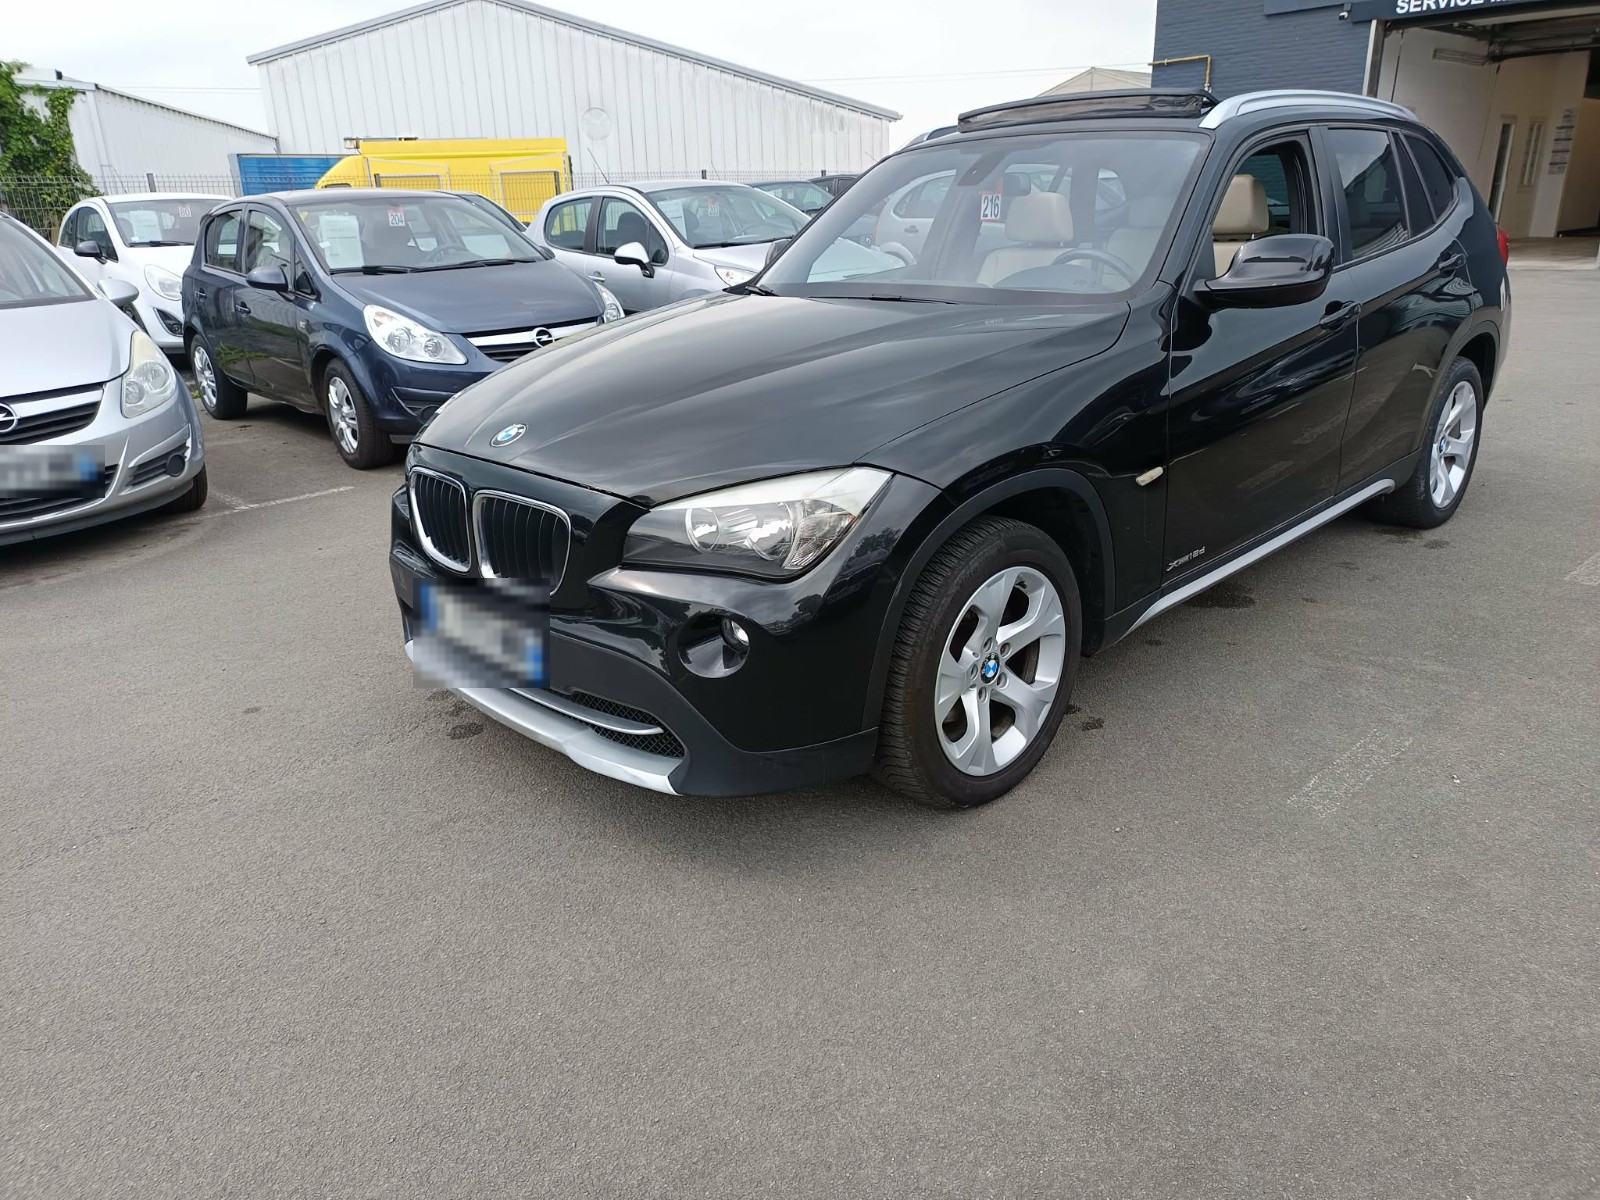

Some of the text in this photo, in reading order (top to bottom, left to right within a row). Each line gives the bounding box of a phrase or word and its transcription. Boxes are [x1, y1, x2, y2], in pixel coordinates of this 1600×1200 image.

[1395, 0, 1484, 14] SERVI
[982, 195, 1000, 218] 216
[390, 213, 404, 225] 204
